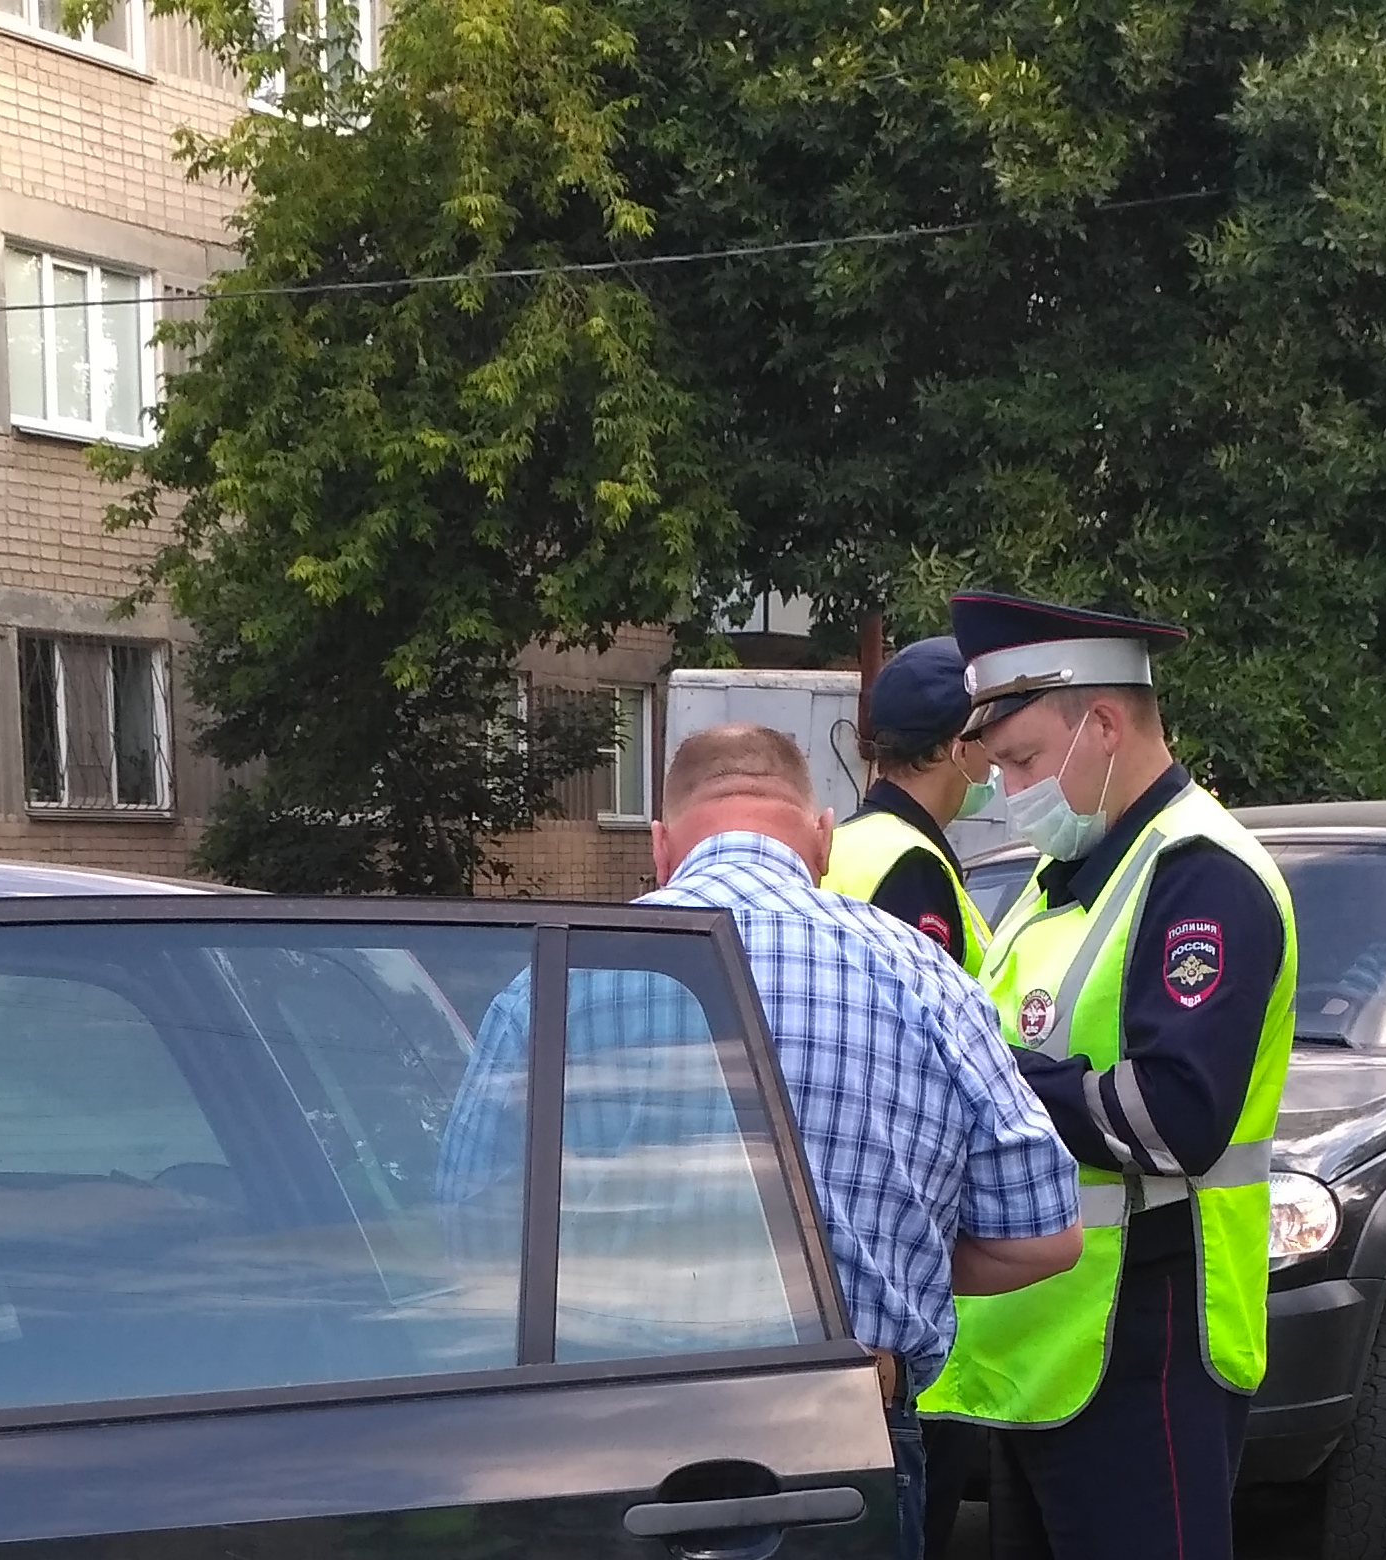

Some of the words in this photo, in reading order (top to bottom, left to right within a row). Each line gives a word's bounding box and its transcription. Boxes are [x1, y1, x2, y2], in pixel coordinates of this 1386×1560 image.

[1168, 922, 1218, 939] ПОЛИЦИЯ
[1171, 941, 1216, 961] РОССИЯ
[1180, 994, 1202, 1008] МВД
